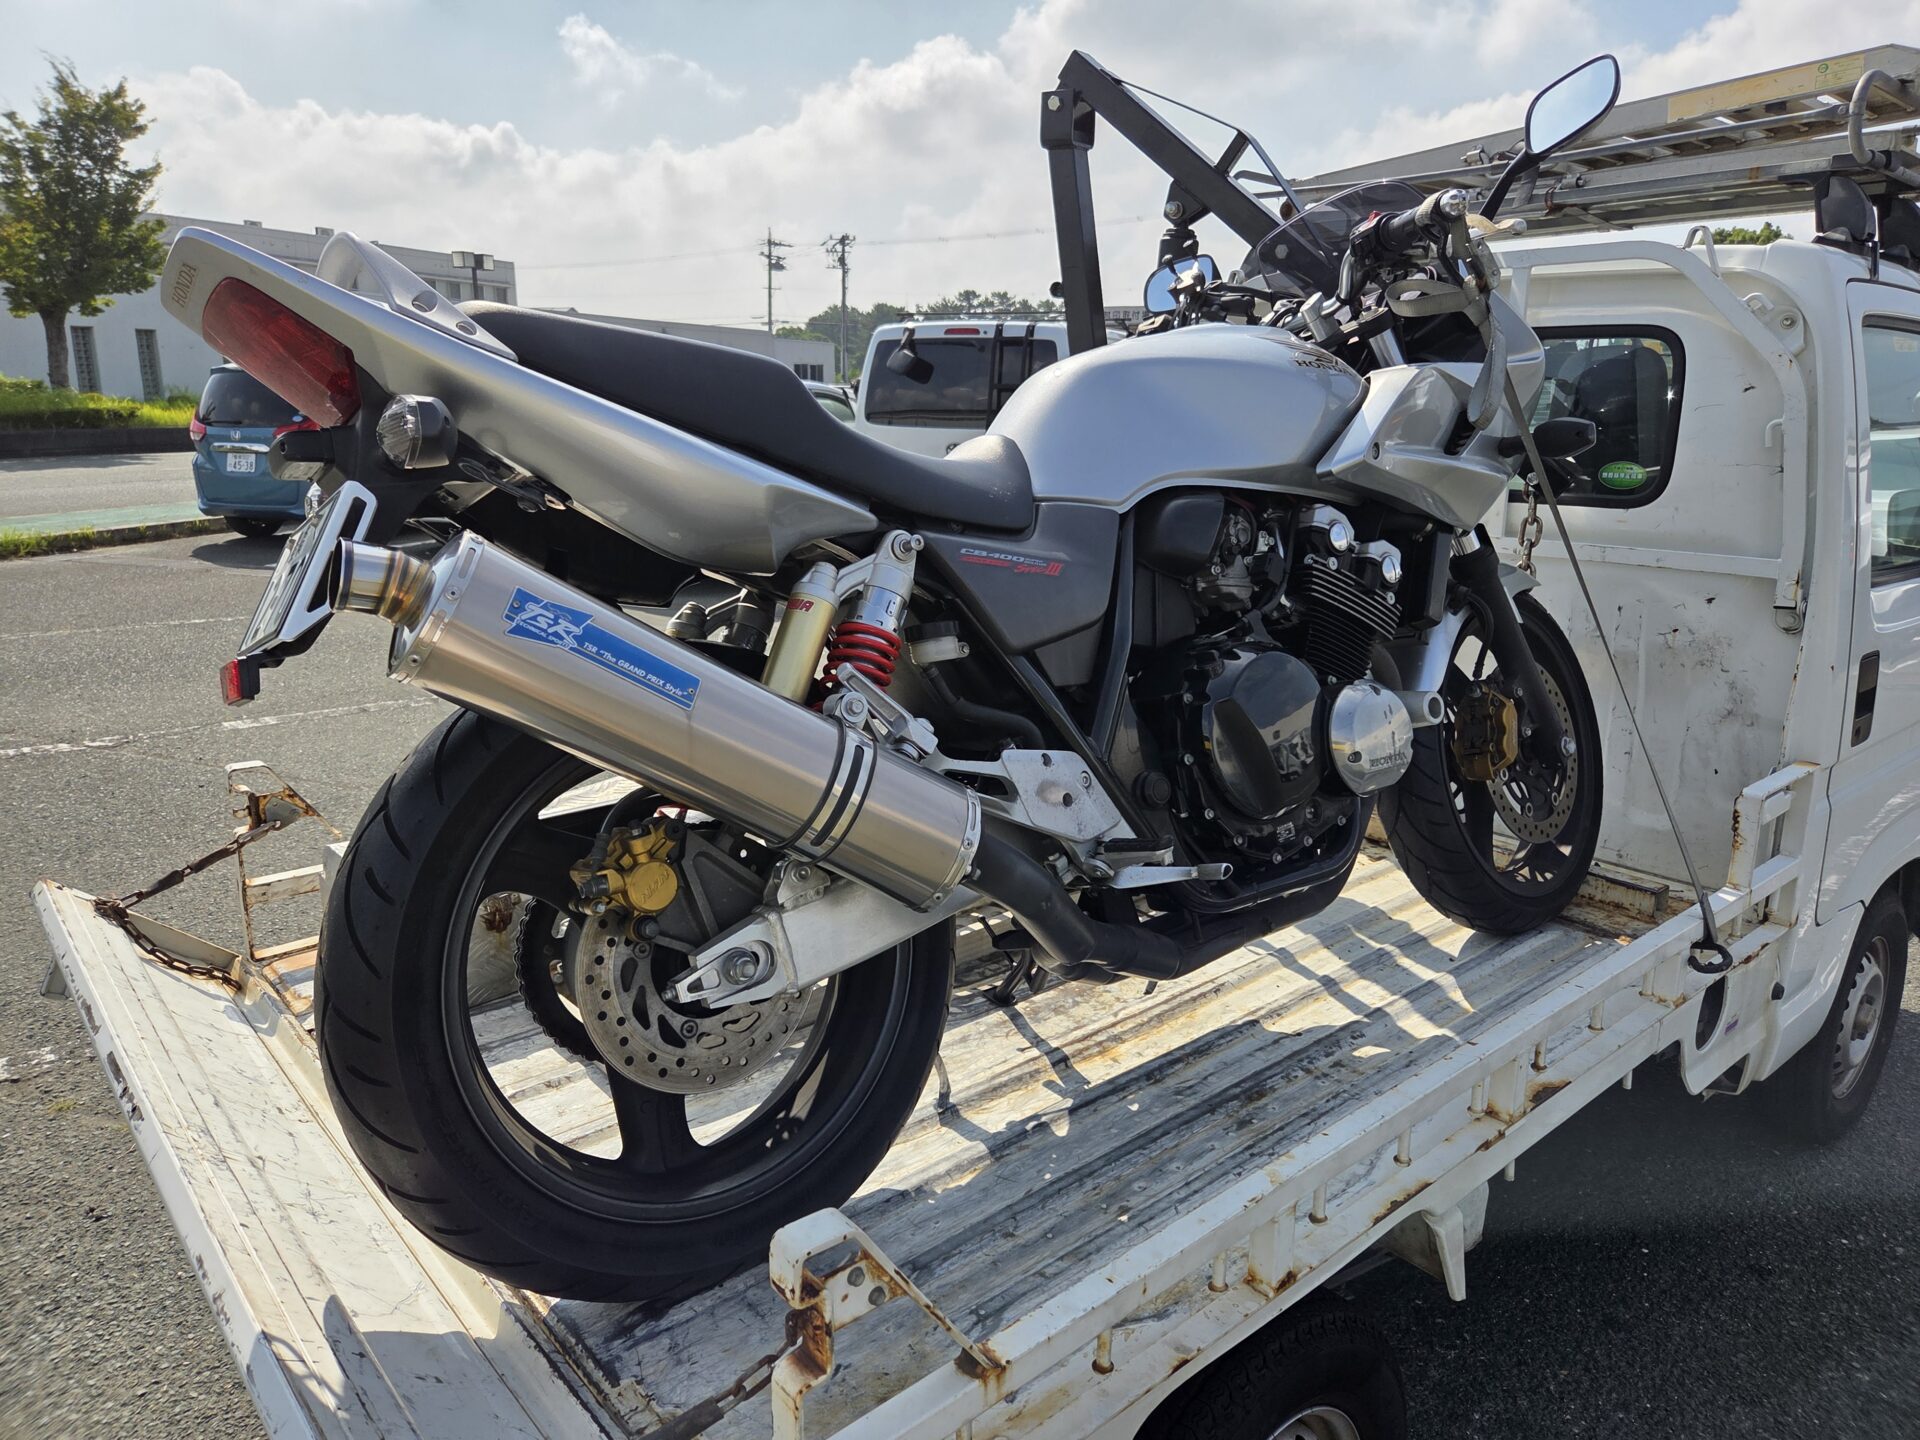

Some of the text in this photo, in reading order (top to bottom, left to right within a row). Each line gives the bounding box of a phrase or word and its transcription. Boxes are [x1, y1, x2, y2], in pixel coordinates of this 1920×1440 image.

[172, 263, 197, 308] HONDA
[1294, 359, 1353, 376] HONDA
[960, 548, 1025, 562] CB400
[516, 618, 548, 639] TECHNICAL
[583, 641, 598, 654] TSR
[617, 659, 646, 678] GRAND
[646, 673, 665, 687] PRIX
